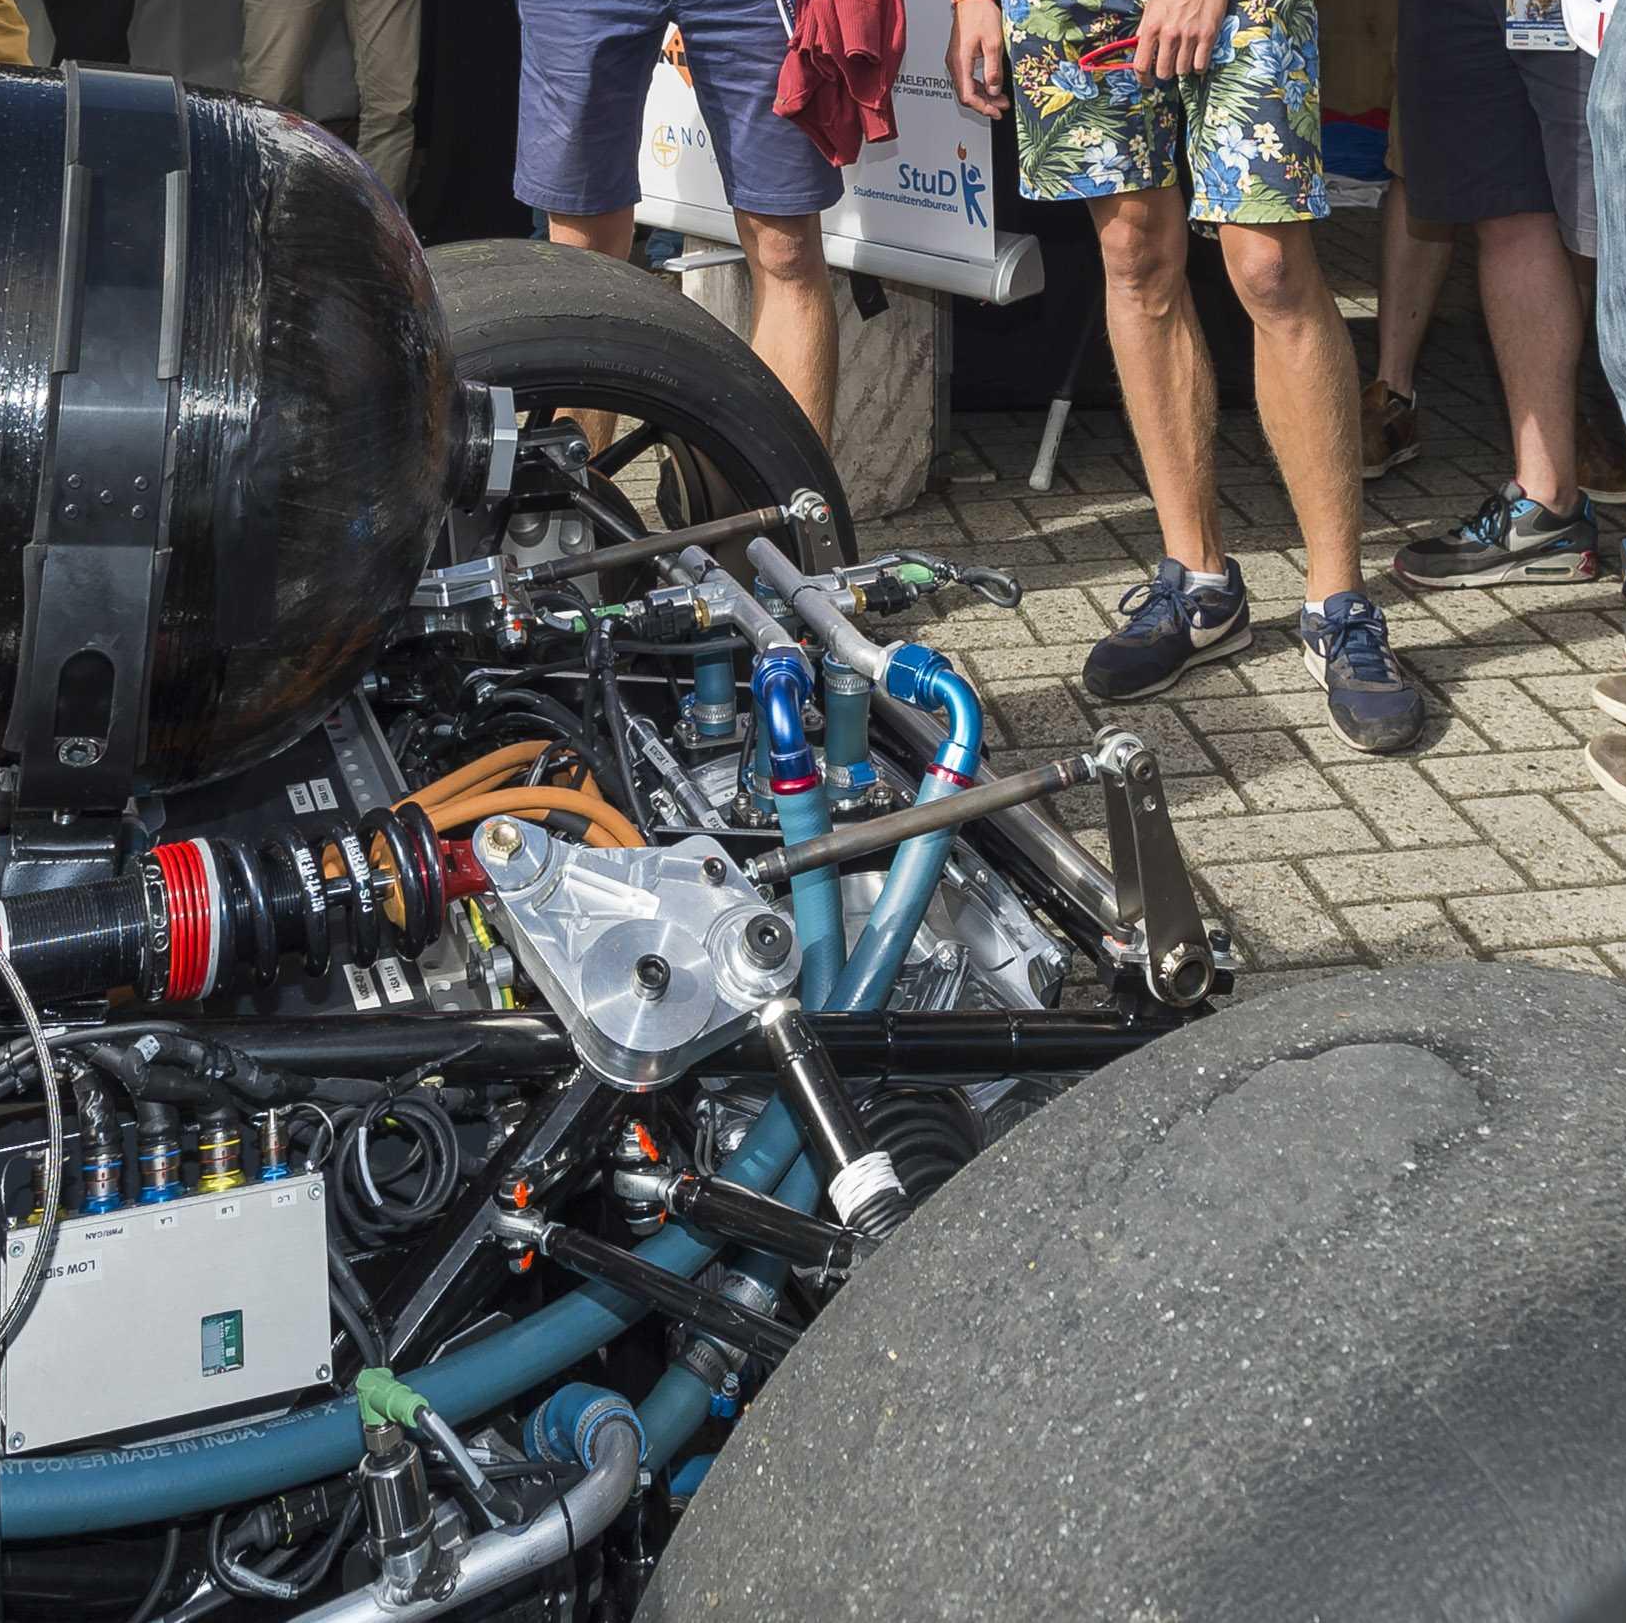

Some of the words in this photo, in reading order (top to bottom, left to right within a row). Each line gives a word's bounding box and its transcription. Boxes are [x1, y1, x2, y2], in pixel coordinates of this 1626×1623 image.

[903, 87, 924, 96] POWER
[925, 89, 953, 100] SUPPLIES
[666, 126, 706, 149] ANO
[853, 184, 958, 214] Studentenuitzendbureau
[67, 1260, 96, 1276] LOW
[31, 1452, 108, 1475] COVER
[112, 1442, 173, 1467] MADE
[176, 1438, 199, 1457] IN
